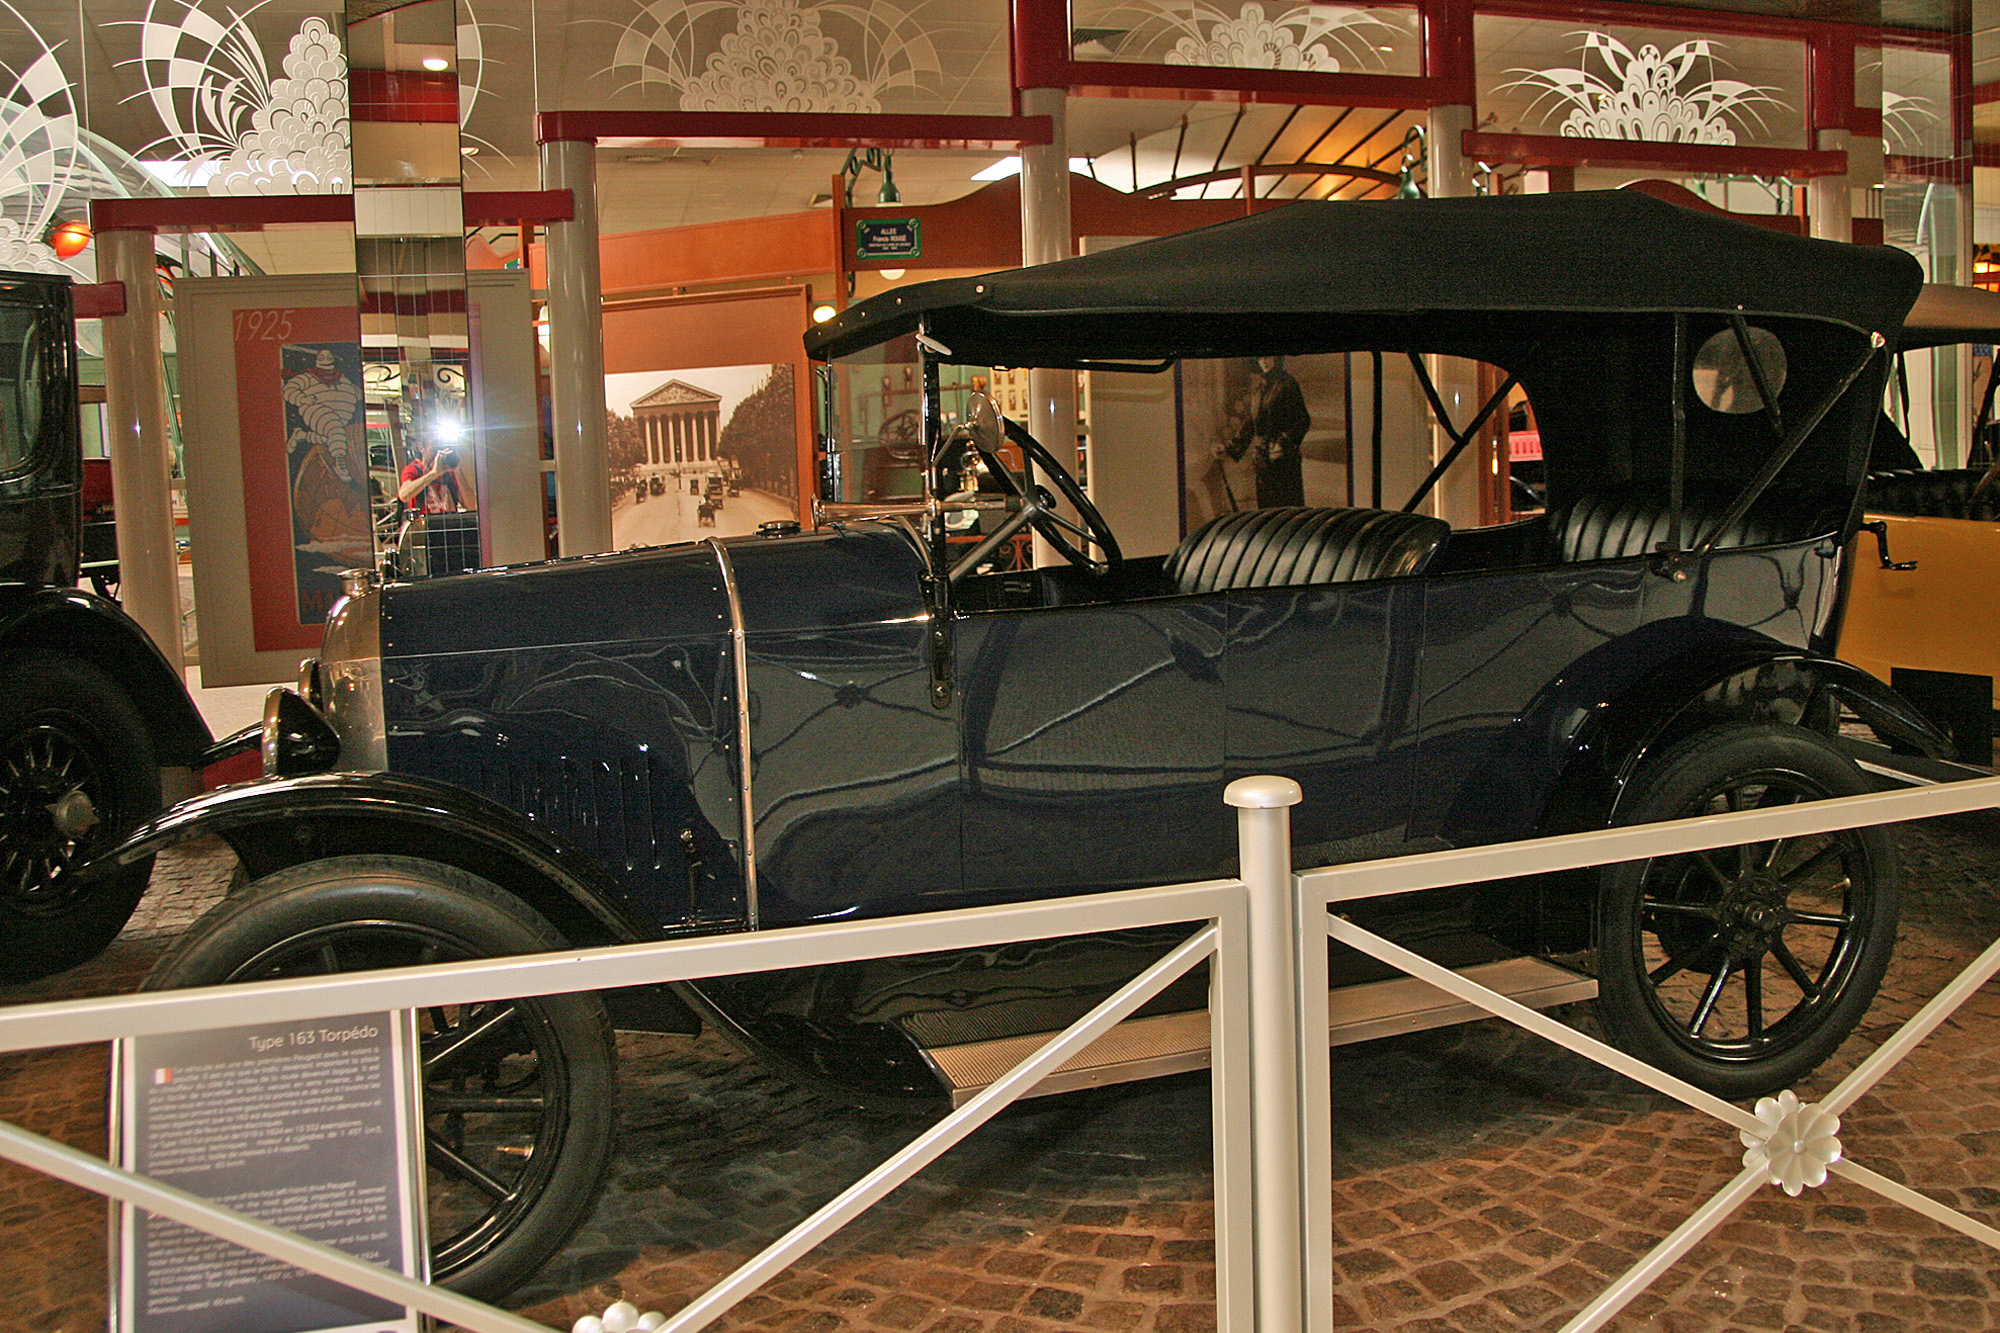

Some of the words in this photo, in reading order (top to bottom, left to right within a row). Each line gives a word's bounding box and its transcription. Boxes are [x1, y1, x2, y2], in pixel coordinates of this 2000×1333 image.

[234, 310, 295, 342] 1925
[249, 1036, 285, 1052] Type
[289, 1030, 316, 1046] 163
[319, 1025, 379, 1042] Torpédo
